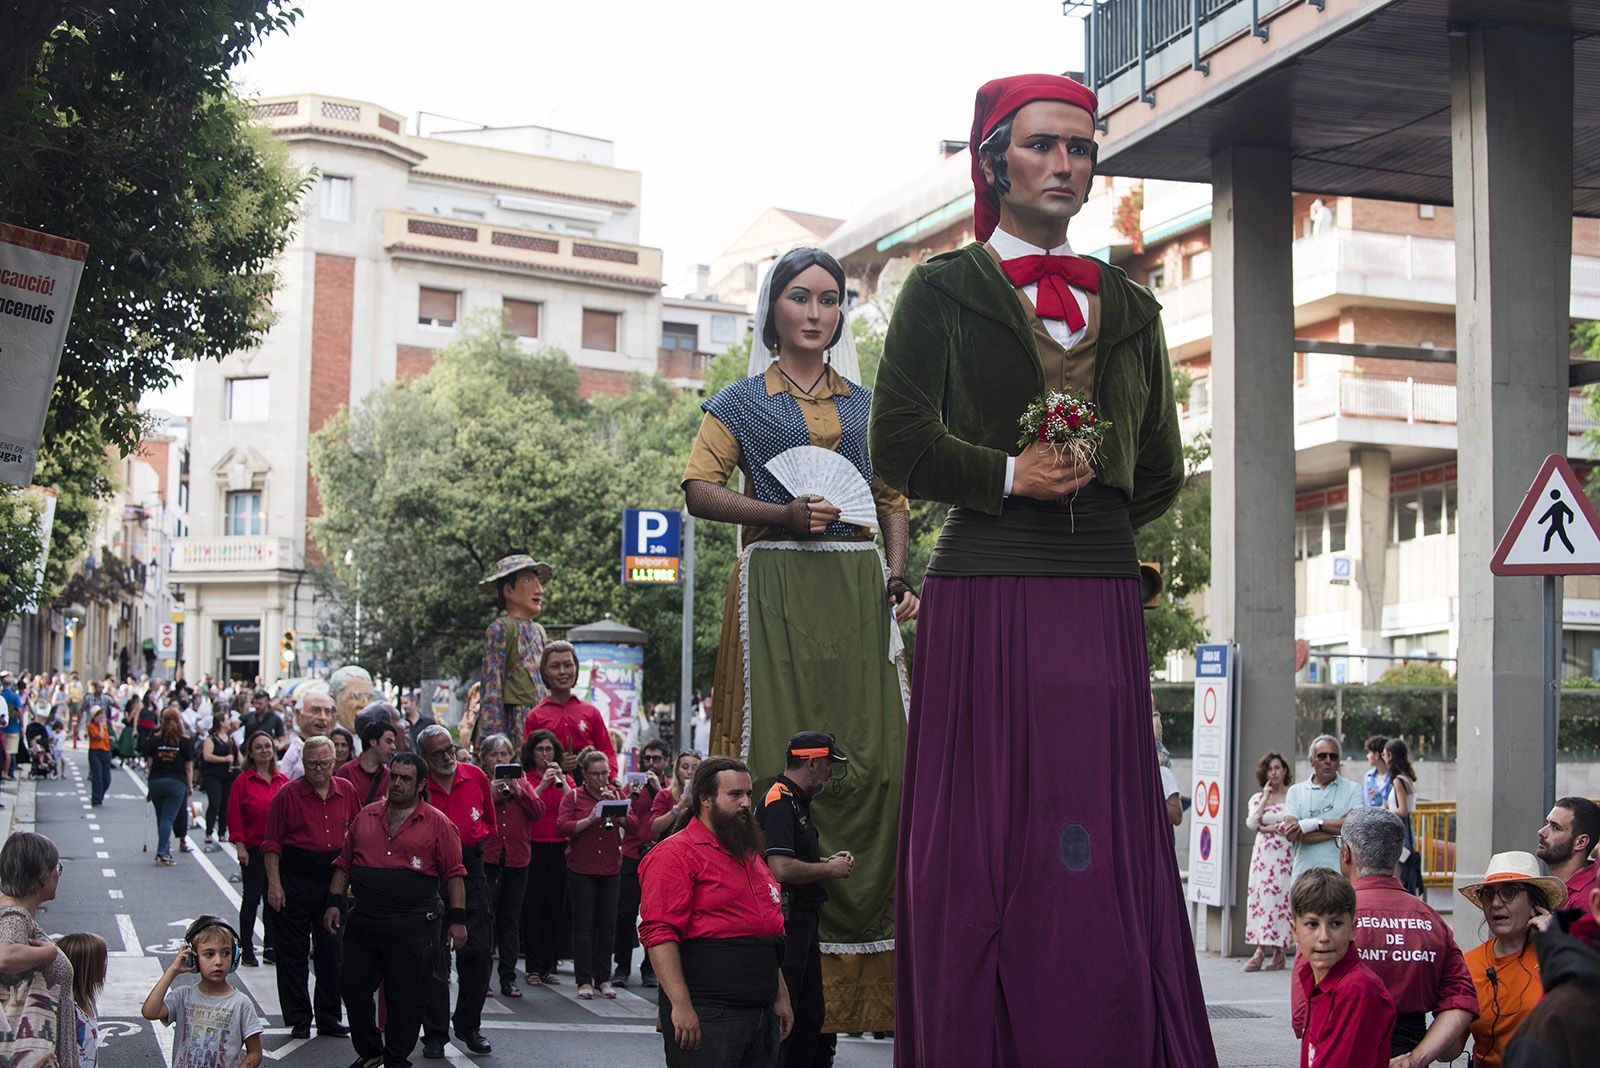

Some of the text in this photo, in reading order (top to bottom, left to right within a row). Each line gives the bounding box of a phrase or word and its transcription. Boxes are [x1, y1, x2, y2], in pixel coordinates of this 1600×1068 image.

[0, 269, 56, 296] caució!
[638, 511, 669, 554] P
[649, 544, 667, 555] 24h
[1385, 933, 1405, 945] DE
[1392, 950, 1437, 963] CUGAT
